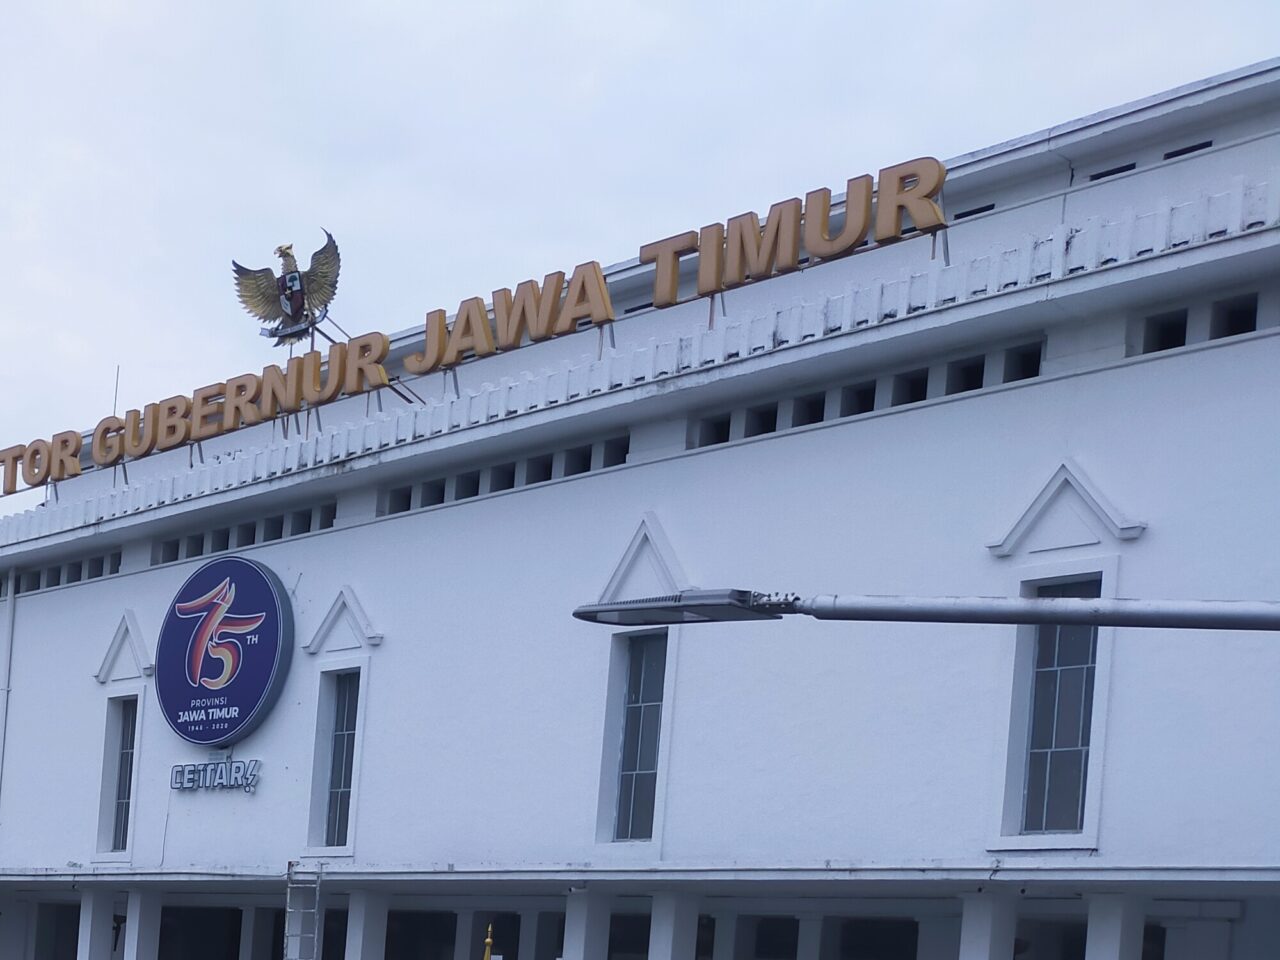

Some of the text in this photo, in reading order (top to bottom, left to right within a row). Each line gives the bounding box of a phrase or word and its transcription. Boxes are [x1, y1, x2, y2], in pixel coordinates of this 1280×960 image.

[91, 331, 390, 467] GUBERNUR
[404, 260, 615, 376] JAWA
[640, 156, 948, 310] TIMUR
[175, 576, 266, 690] 75
[246, 634, 259, 645] TH
[190, 697, 228, 708] PROVINSI
[177, 706, 240, 723] JAWA TIMUR
